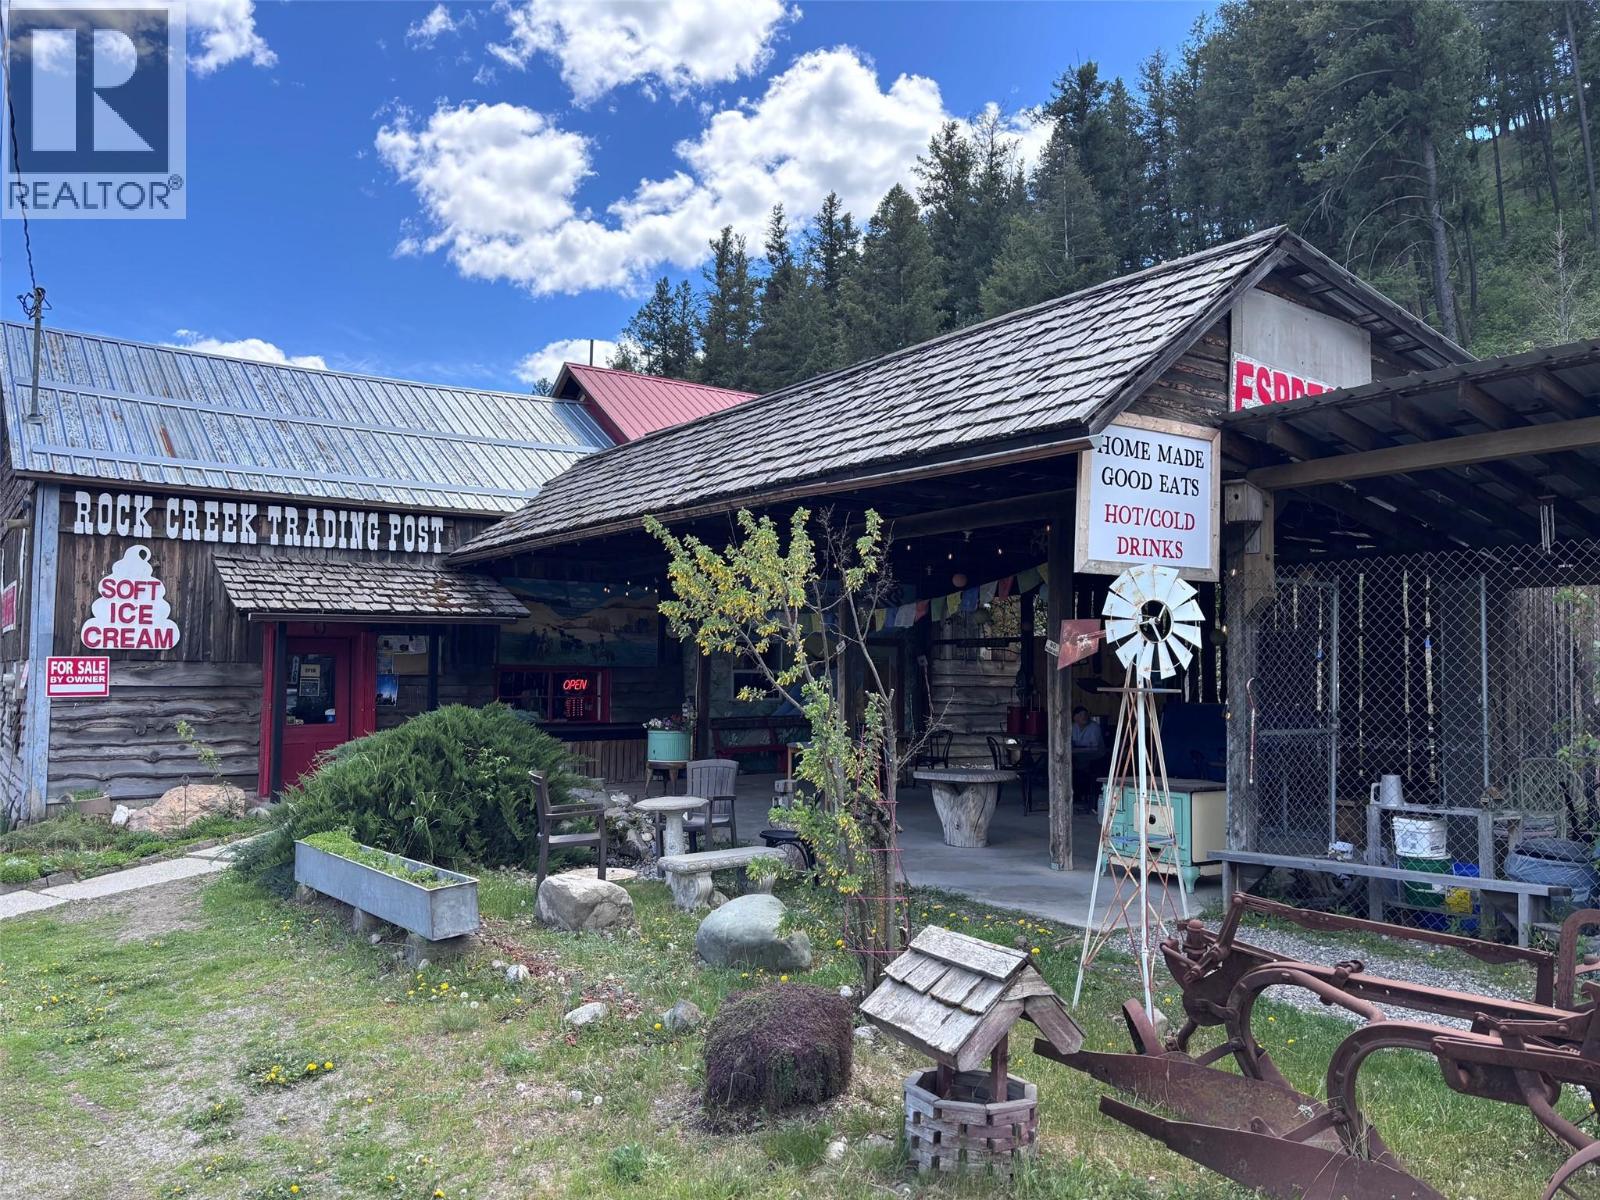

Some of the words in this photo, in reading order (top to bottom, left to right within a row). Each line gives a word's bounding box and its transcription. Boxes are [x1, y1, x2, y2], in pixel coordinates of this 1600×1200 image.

[1098, 435, 1150, 460] HOME
[1158, 444, 1204, 468] MADE
[1102, 467, 1152, 490] GOOD
[1160, 475, 1199, 496] EATS
[74, 491, 153, 538] ROCK
[166, 498, 257, 544] CREEK
[268, 506, 381, 550] TRADING
[389, 514, 444, 553] POST
[1105, 504, 1195, 531] HOT/COLD
[1117, 536, 1183, 559] DRINKS
[101, 579, 160, 600] SOFT
[111, 603, 153, 624] ICE
[83, 627, 173, 648] CREAM
[51, 661, 73, 674] FOR
[78, 661, 105, 674] SALE
[563, 680, 587, 689] OPEN
